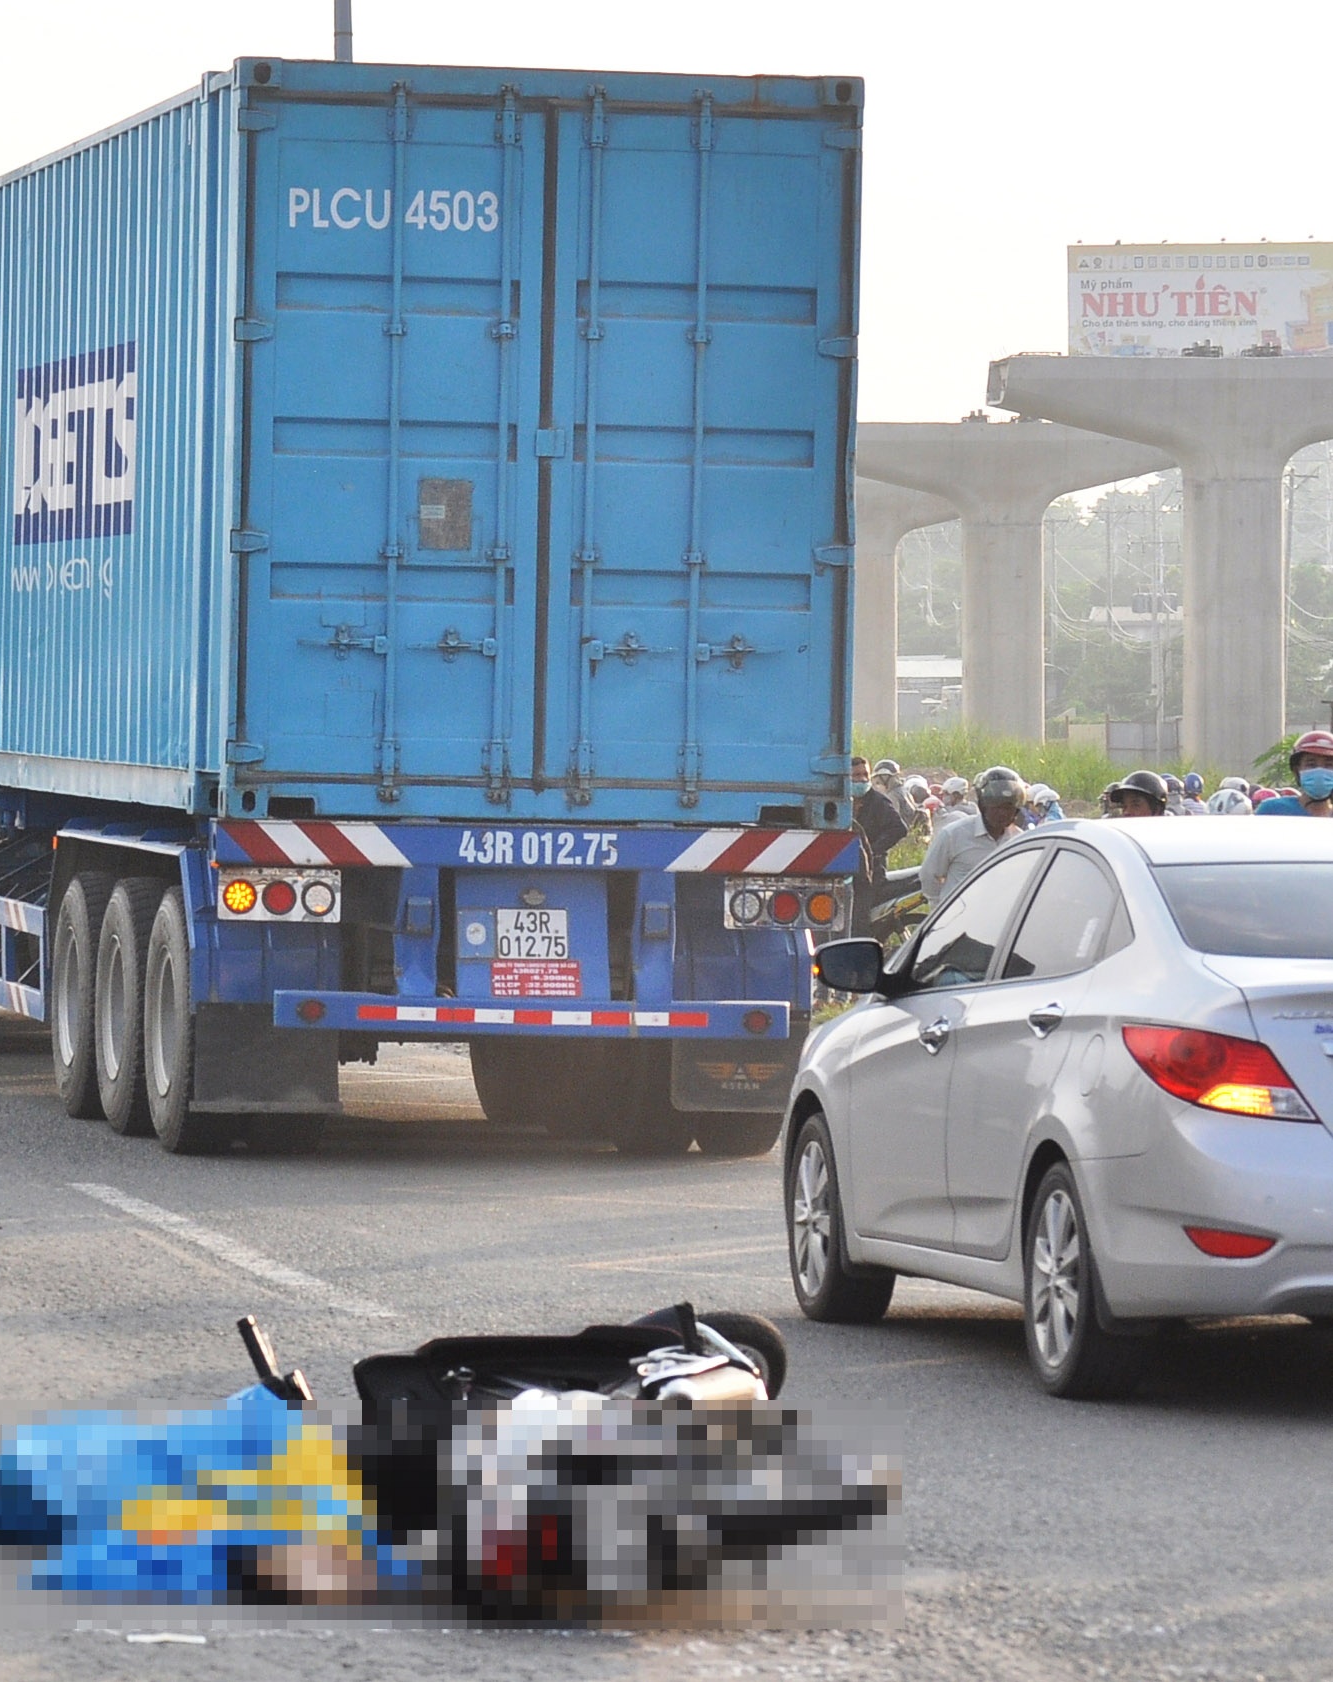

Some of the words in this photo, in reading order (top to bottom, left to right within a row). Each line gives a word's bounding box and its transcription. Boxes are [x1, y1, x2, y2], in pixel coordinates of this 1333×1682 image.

[289, 187, 391, 229] PLCU
[404, 190, 499, 232] 4503
[1080, 280, 1097, 291] Mỹ
[1100, 277, 1133, 291] phẩm
[459, 830, 514, 864] 43R
[522, 832, 618, 866] 012.75
[514, 911, 550, 933] 43R
[499, 935, 566, 957] 012.75
